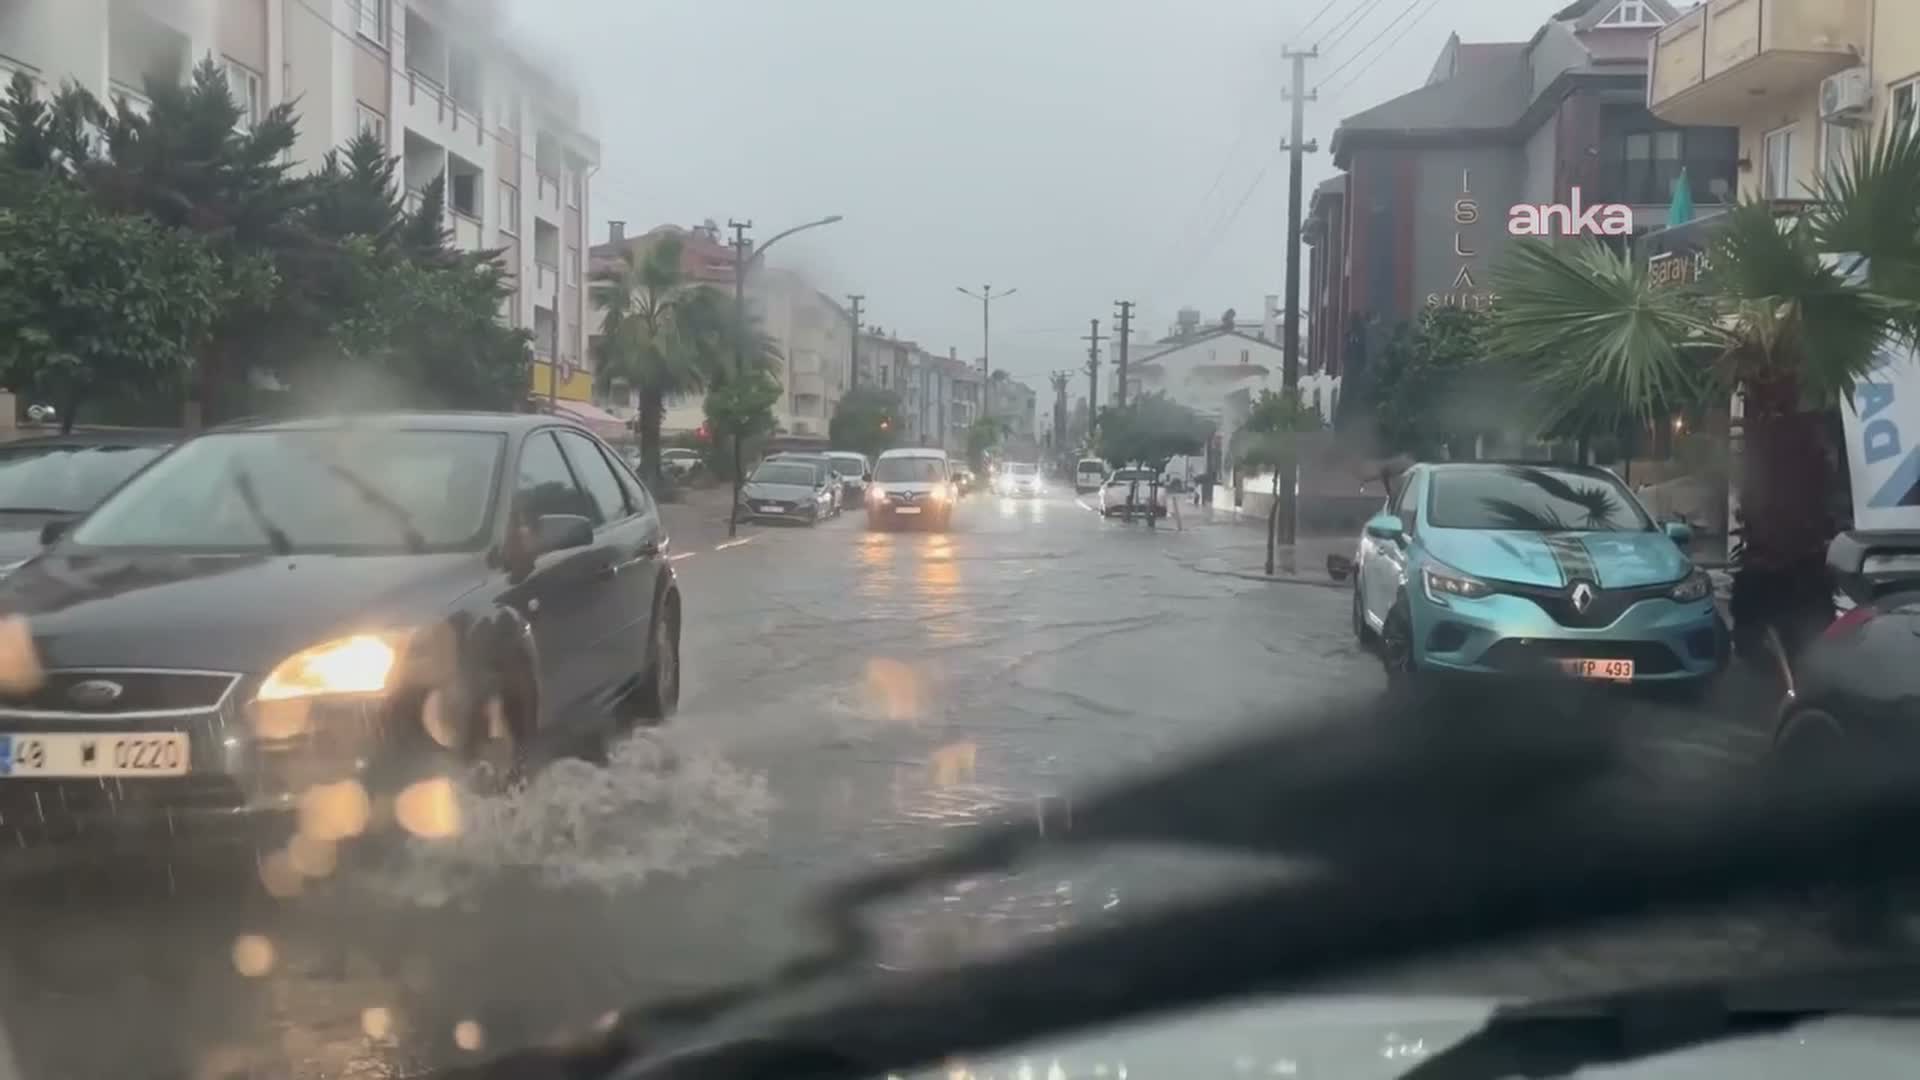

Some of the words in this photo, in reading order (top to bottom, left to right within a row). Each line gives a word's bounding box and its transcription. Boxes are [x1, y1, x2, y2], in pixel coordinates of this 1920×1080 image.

[1453, 168, 1479, 287] ISLA
[1651, 256, 1689, 285] saray
[1605, 662, 1630, 676] 493
[115, 740, 180, 769] 0220
